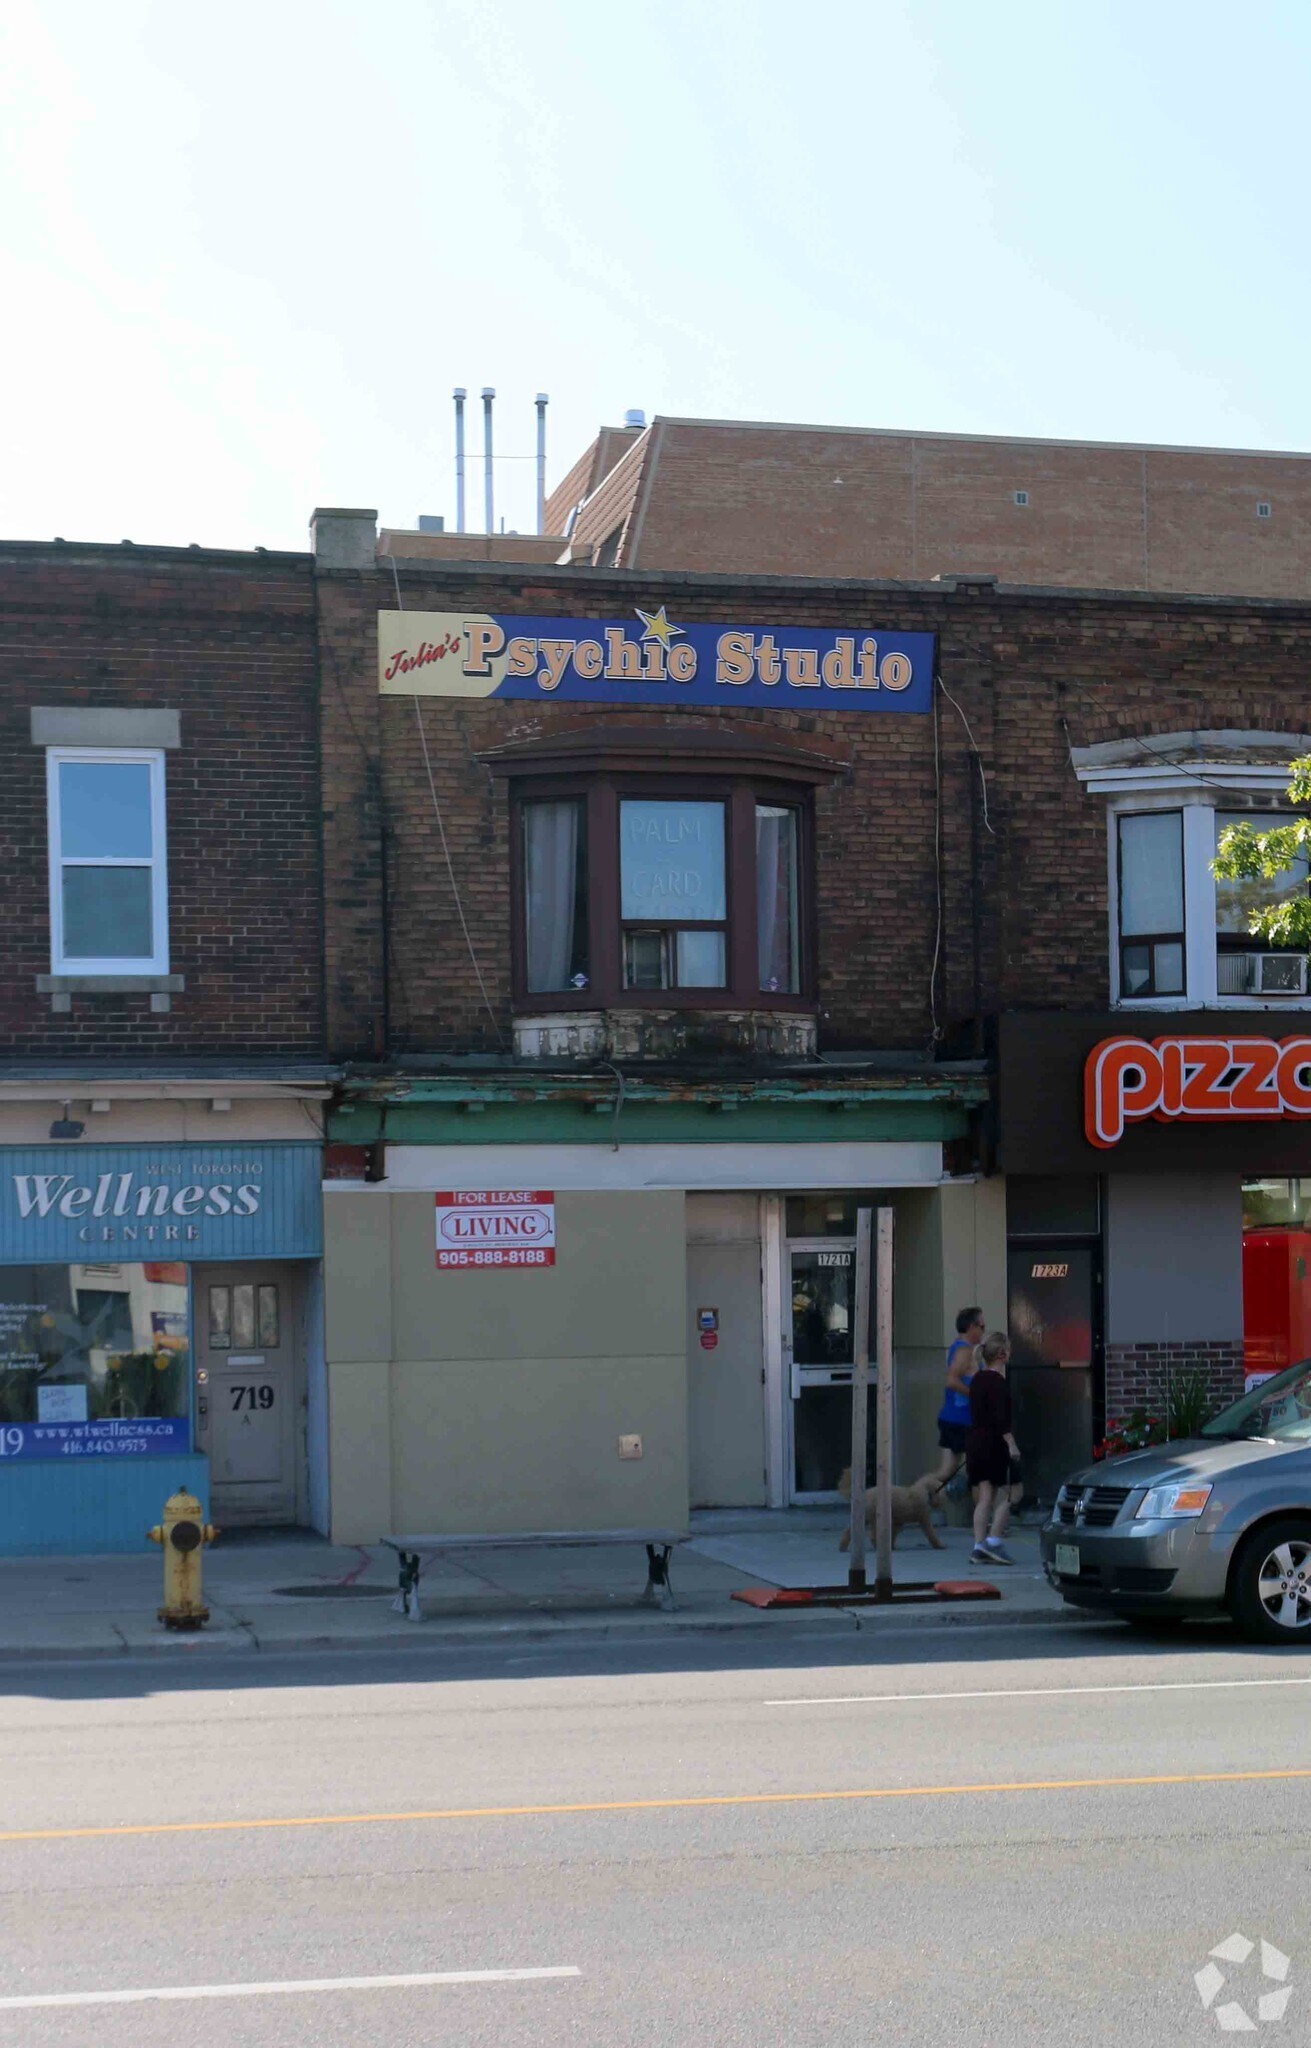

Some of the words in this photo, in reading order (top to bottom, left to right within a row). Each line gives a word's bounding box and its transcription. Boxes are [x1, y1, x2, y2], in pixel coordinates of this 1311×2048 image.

[384, 632, 461, 681] Julia's
[463, 621, 698, 690] Psychic
[716, 631, 912, 691] Studio
[630, 817, 702, 843] PALM
[147, 1164, 182, 1175] WEST
[193, 1163, 263, 1175] TORONTO
[12, 1172, 261, 1219] Wellness
[458, 1192, 487, 1203] FOR
[491, 1191, 532, 1203] LEASE
[79, 1225, 201, 1242] CENTRE
[454, 1216, 537, 1236] LIVING
[440, 1250, 546, 1265] 905-888-8188
[818, 1254, 850, 1266] 1721A
[1031, 1264, 1068, 1278] 1723A
[230, 1385, 275, 1411] 719
[61, 1438, 148, 1455] 416.840.9575
